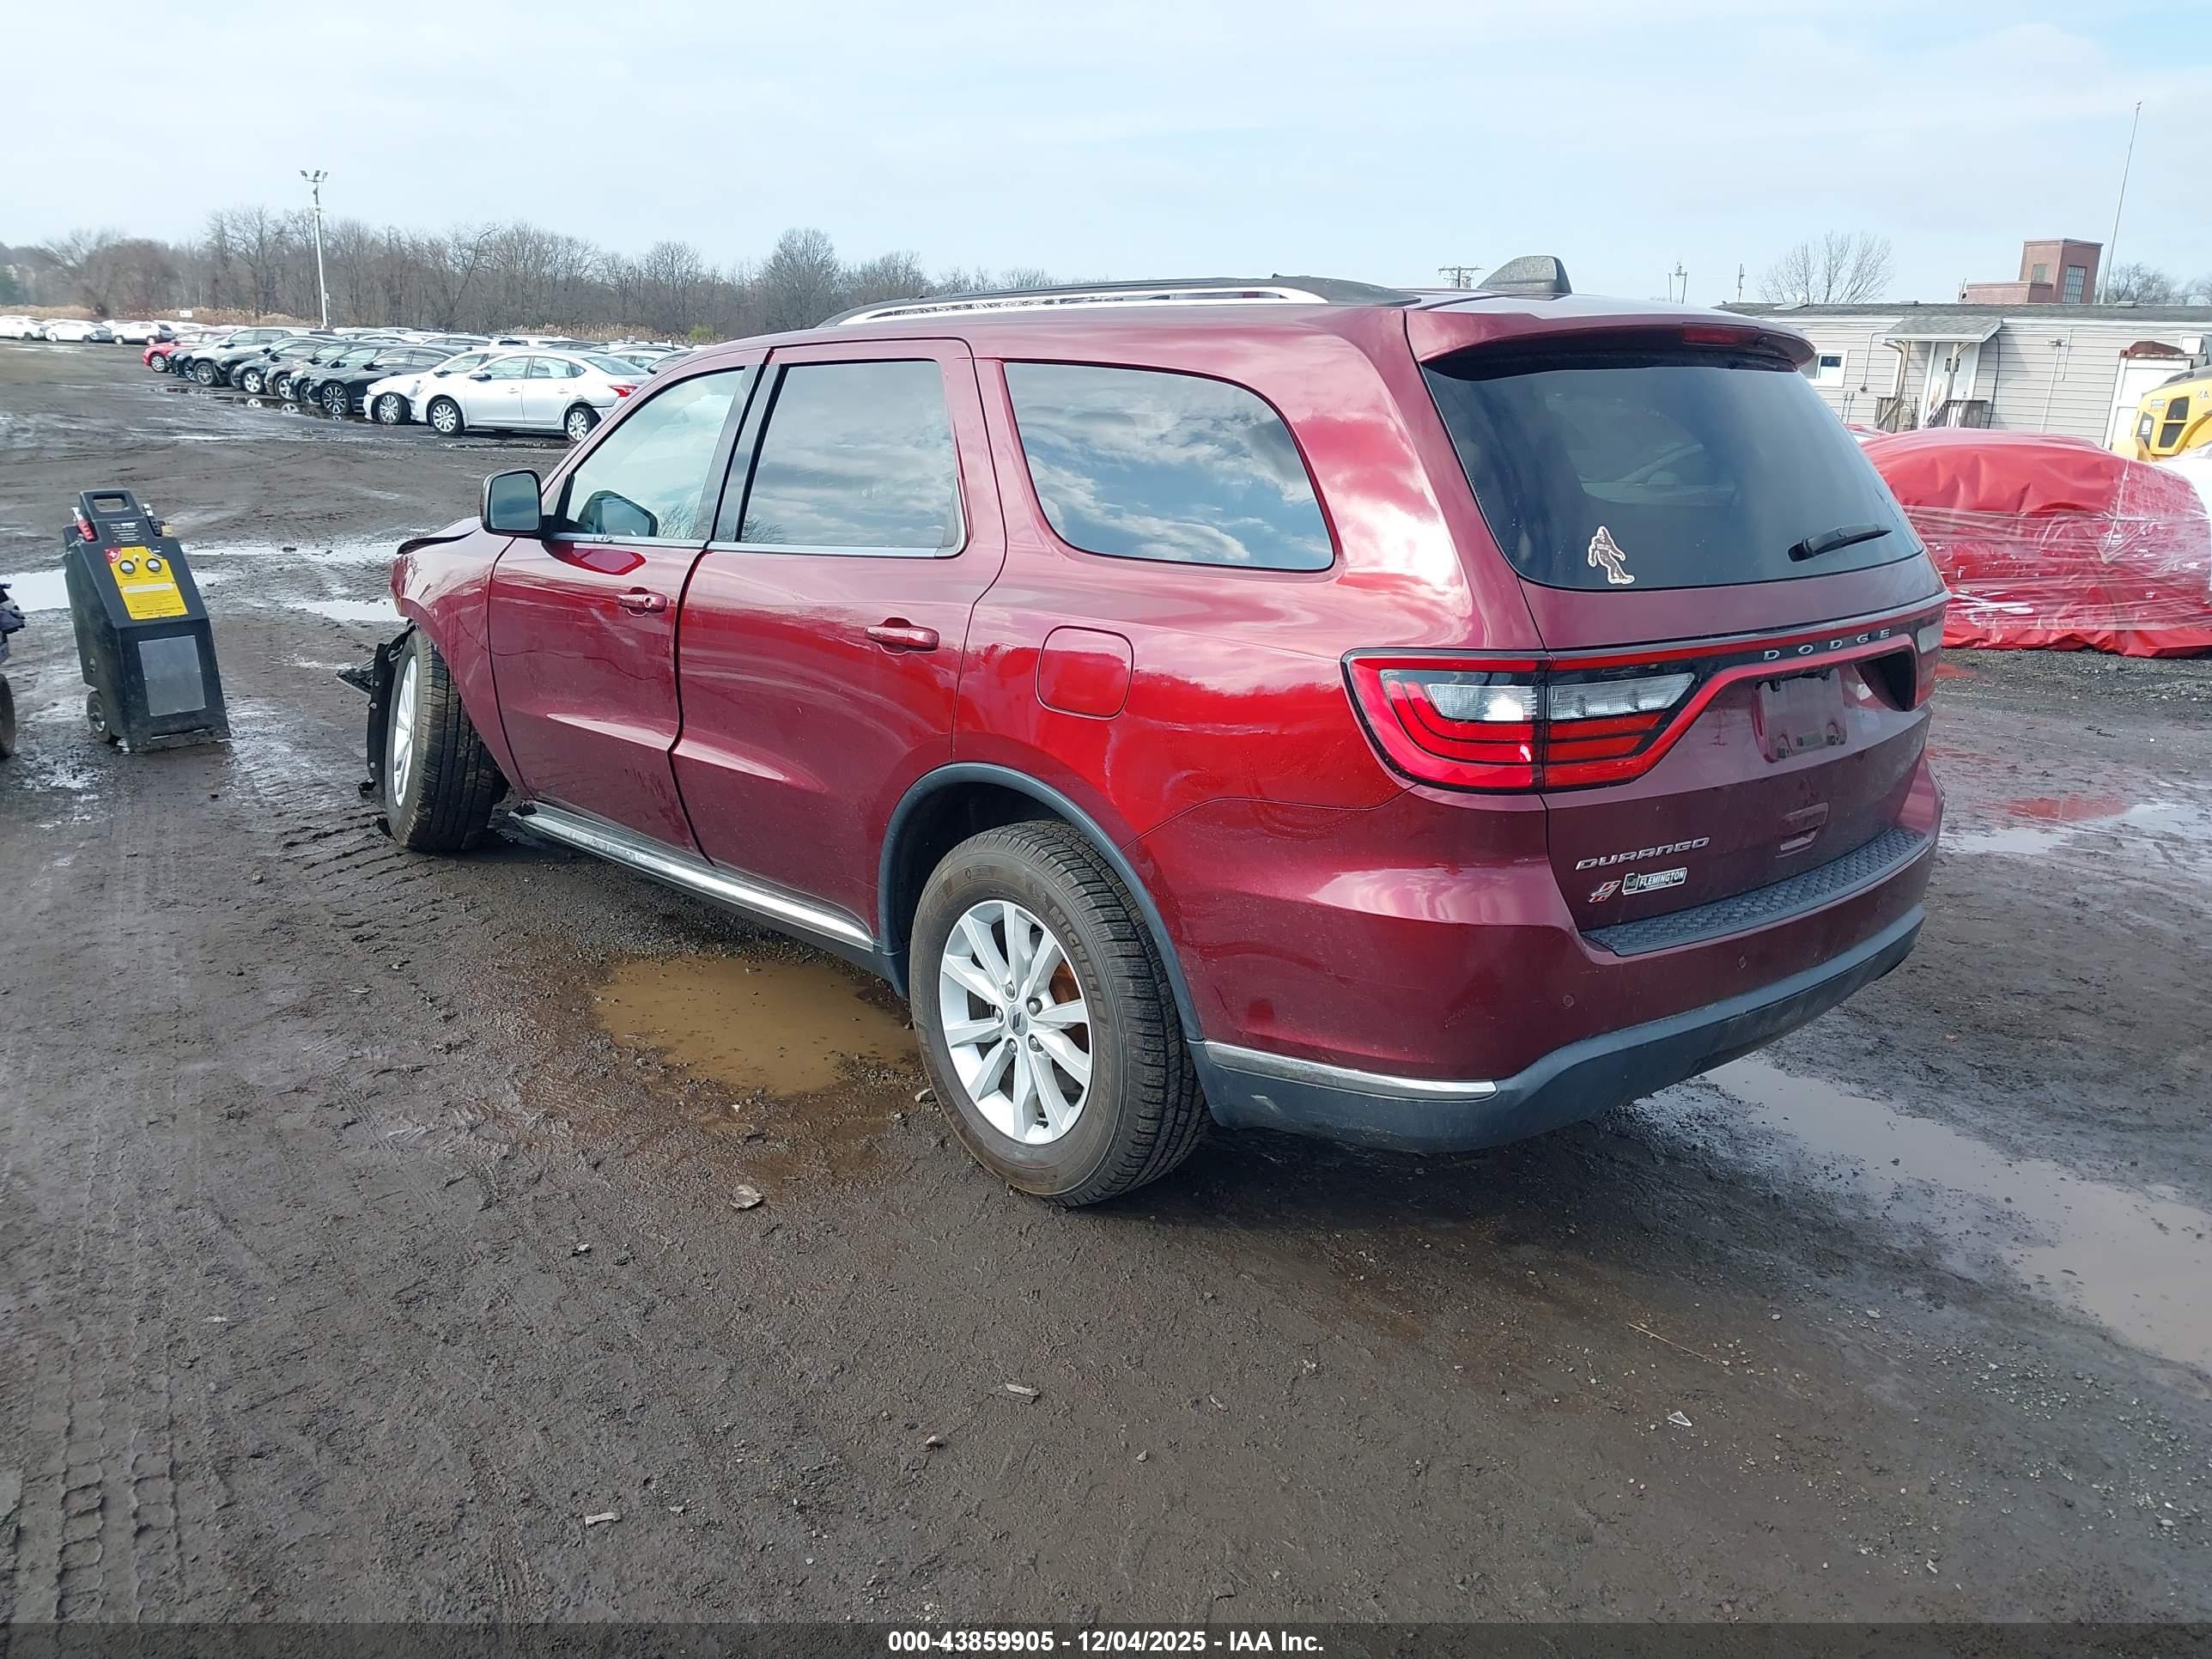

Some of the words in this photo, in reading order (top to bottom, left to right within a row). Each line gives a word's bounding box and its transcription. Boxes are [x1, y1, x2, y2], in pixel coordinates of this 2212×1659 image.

[1763, 629, 1890, 660] DODGE
[1575, 836, 1711, 871] DURANGO
[1638, 870, 1685, 888] FLEMINGTON
